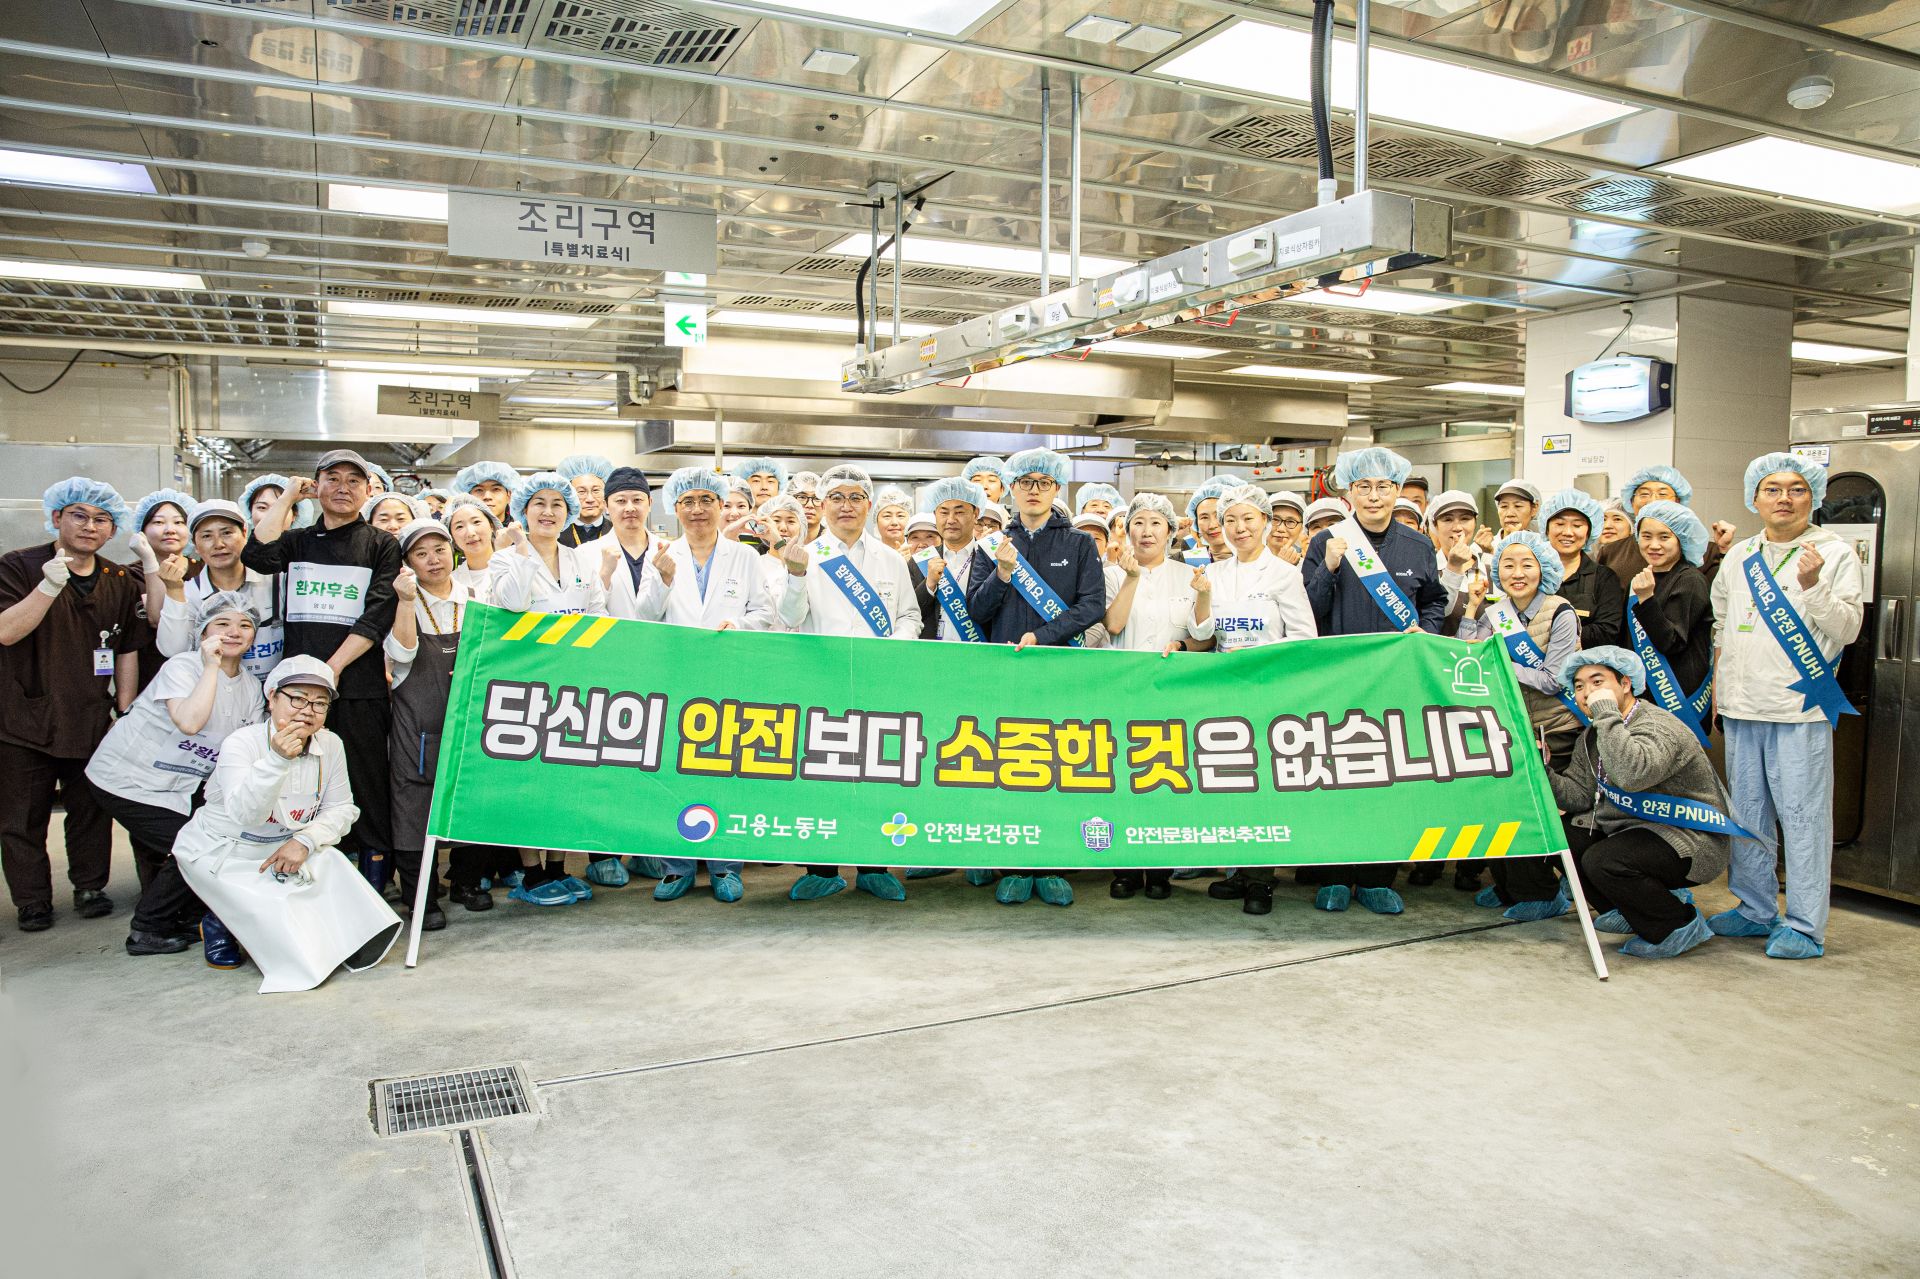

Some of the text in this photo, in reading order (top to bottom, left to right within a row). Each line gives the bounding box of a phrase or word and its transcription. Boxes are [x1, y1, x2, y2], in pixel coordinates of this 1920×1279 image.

[517, 201, 655, 244] 조리구역
[408, 390, 471, 409] 조리구역
[295, 579, 359, 601] 환자후송
[835, 564, 871, 610] 함께해요,
[869, 605, 888, 631] 안전
[949, 598, 969, 621] 안전
[1375, 581, 1411, 627] 함께해요,
[1749, 561, 1776, 611] 함께해요,
[1770, 607, 1797, 636] 안전
[1788, 633, 1825, 680] PNUH!
[1641, 645, 1662, 671] 안전
[1652, 669, 1683, 713] PNUH!
[482, 679, 667, 772] 당신의
[935, 714, 1115, 793] 소중한
[1122, 714, 1259, 793] 것은
[1269, 705, 1514, 792] 없습니다
[725, 813, 838, 840] 고용노동부
[1642, 800, 1671, 818] 안전
[1674, 804, 1726, 827] PNUH!
[924, 822, 1042, 846] 안전보건공단
[1086, 825, 1109, 837] 안전
[1126, 824, 1291, 845] 안전문화실천추진단
